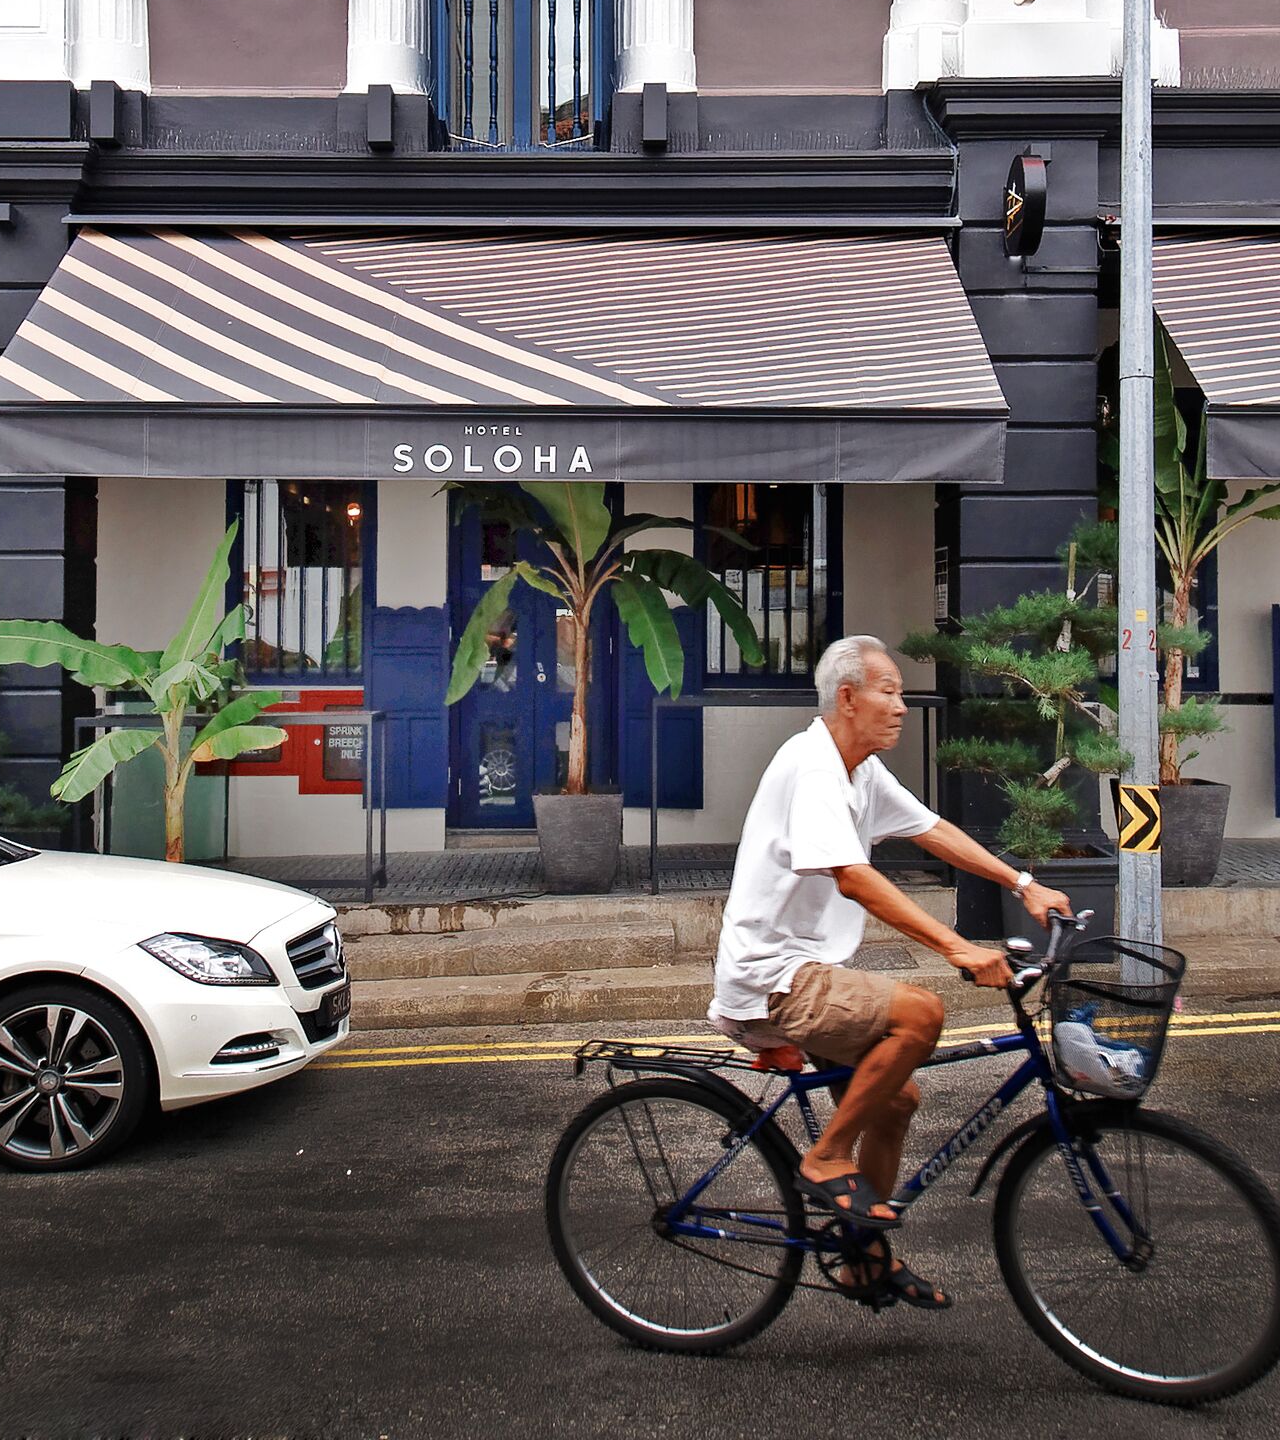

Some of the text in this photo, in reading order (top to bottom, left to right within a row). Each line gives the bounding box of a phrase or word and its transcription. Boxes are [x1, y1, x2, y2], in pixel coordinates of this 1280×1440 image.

[464, 425, 523, 436] HOTEL
[392, 443, 594, 474] SOLOHA
[329, 726, 363, 736] SPRINK
